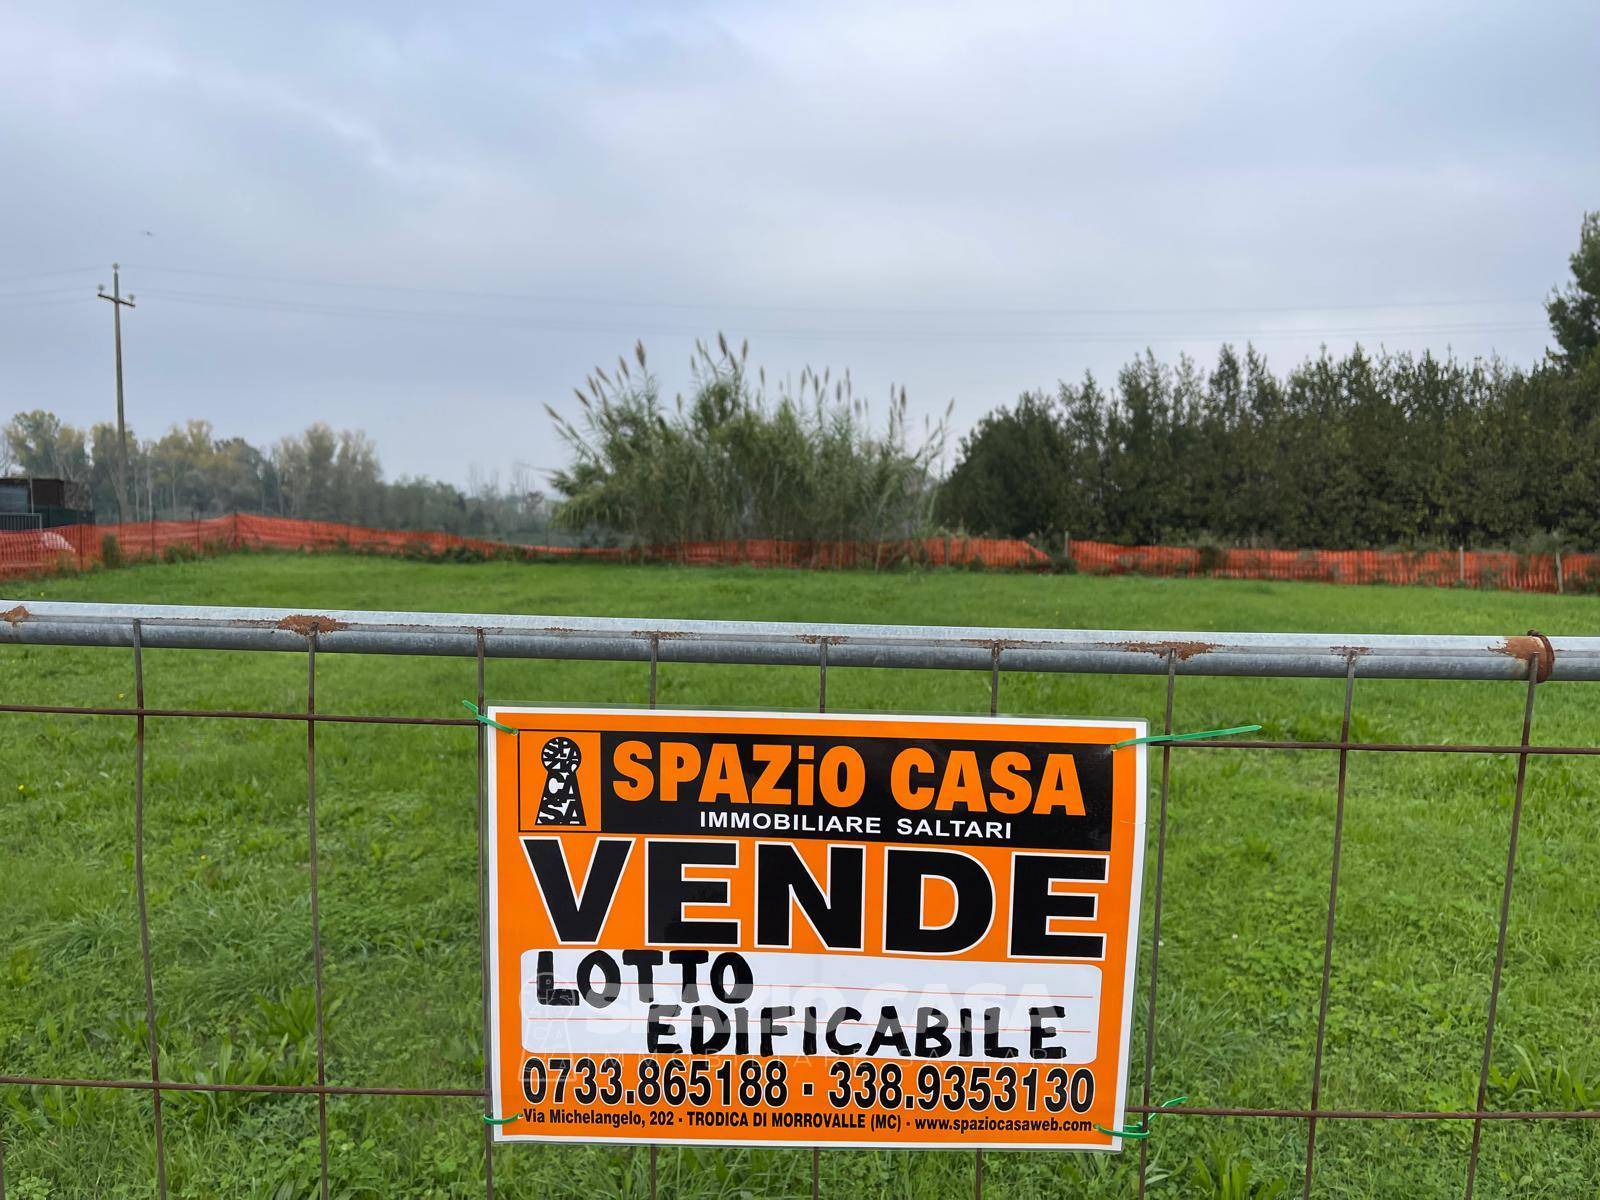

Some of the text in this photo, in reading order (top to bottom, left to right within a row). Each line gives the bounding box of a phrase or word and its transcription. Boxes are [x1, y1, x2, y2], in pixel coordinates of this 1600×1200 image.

[891, 746, 1086, 817] CASA
[700, 811, 1012, 840] IMMOBILIARE SALTARI
[519, 836, 1109, 959] VENDE
[536, 950, 754, 1009] LOTTO
[647, 1004, 1067, 1059] EDIFICABILE
[522, 1057, 788, 1107] 0733.865188
[828, 1061, 1096, 1113] 338.9353130
[523, 1108, 545, 1124] Via
[549, 1109, 646, 1129] Michelangelo,
[649, 1112, 674, 1126] 202
[687, 1112, 749, 1127] TRODICA
[753, 1113, 767, 1127] DI
[771, 1112, 866, 1129] MORROVALLE
[870, 1113, 901, 1132] (MC)
[914, 1116, 1092, 1134] www.spaziocasaweb.com
